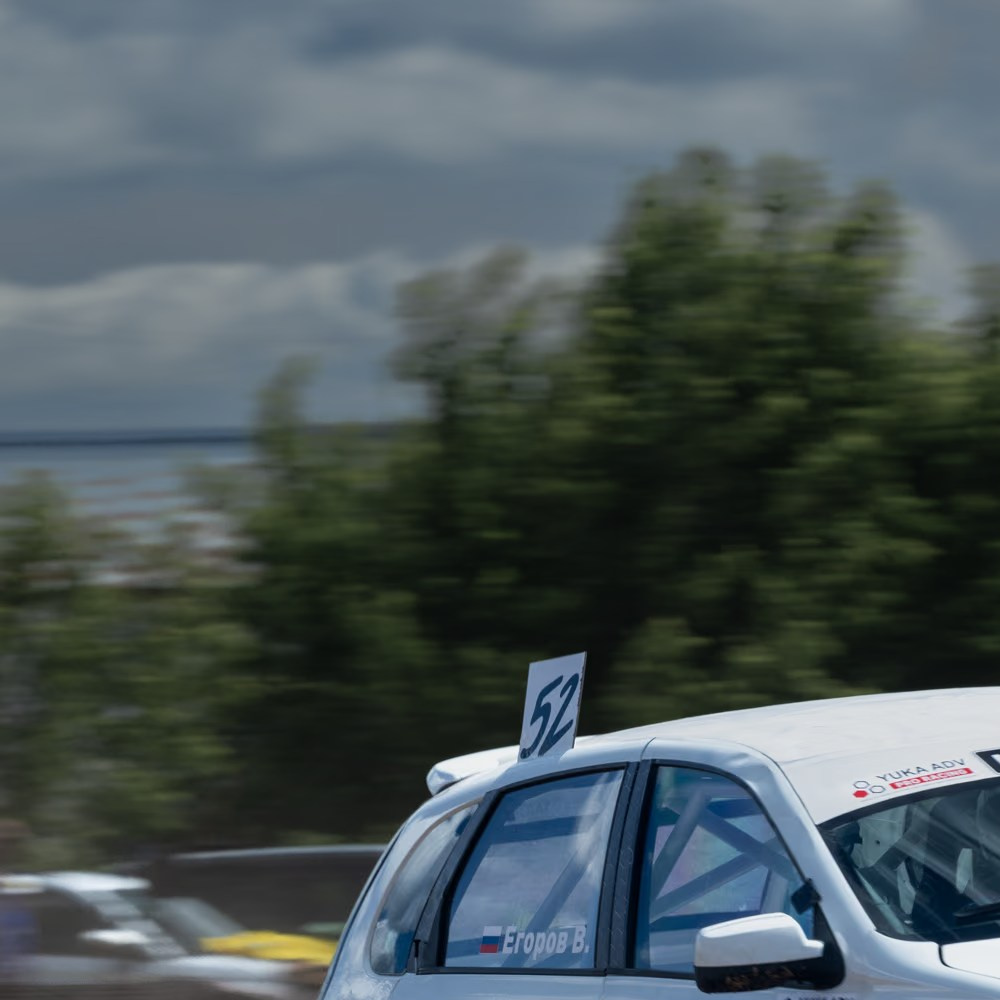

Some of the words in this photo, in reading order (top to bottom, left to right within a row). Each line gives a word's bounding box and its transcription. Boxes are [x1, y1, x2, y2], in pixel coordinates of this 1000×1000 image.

[520, 672, 580, 759] 52
[876, 766, 929, 782] YUKA
[931, 758, 967, 772] ADV
[893, 777, 920, 788] PRO
[922, 769, 967, 782] RACING
[502, 925, 568, 960] Егоров
[571, 923, 590, 954] В.
